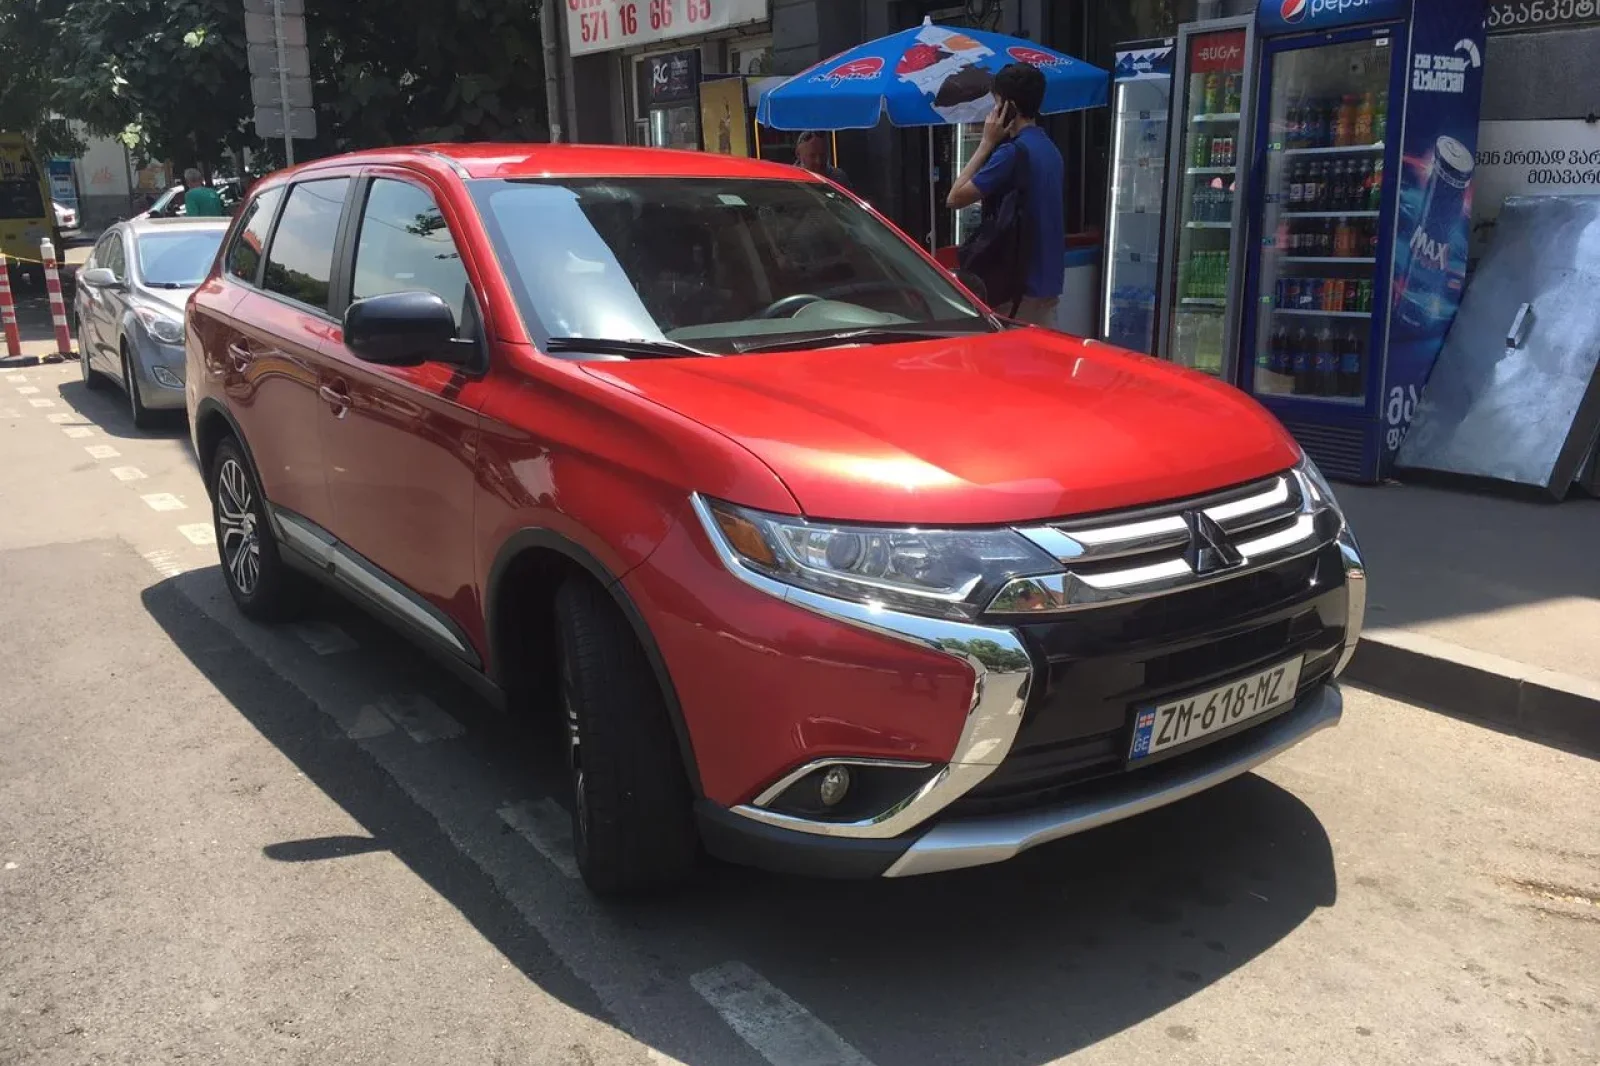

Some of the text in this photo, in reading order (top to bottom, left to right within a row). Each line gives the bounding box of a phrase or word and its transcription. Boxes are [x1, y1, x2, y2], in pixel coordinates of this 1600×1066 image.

[581, 10, 609, 42] 571
[620, 4, 638, 36] 16
[650, 0, 672, 30] 66
[1482, 0, 1600, 28] აბანკეტ
[1199, 46, 1240, 60] BUGA
[1504, 150, 1566, 164] ერთად
[1410, 225, 1448, 270] MAX
[1155, 668, 1286, 746] ZM-618-MZ
